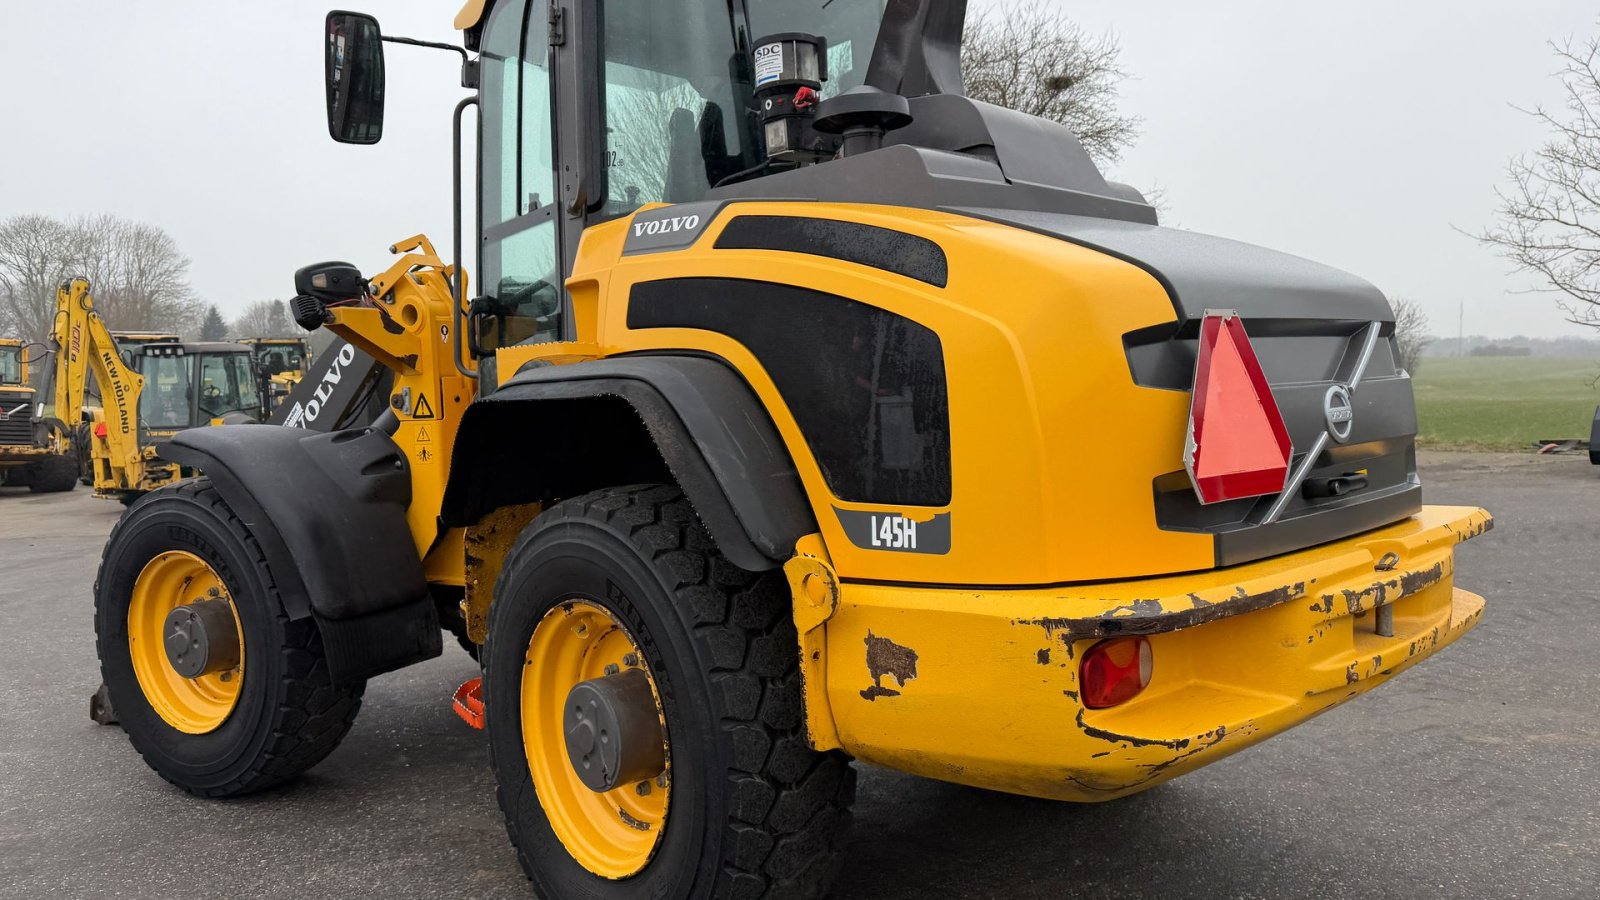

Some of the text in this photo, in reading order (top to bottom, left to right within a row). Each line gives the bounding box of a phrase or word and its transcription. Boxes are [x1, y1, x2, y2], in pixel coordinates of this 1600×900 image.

[756, 44, 780, 59] SDC
[634, 214, 699, 237] VOLVO
[103, 352, 130, 434] NEW HOLLAND
[871, 515, 917, 549] L45H
